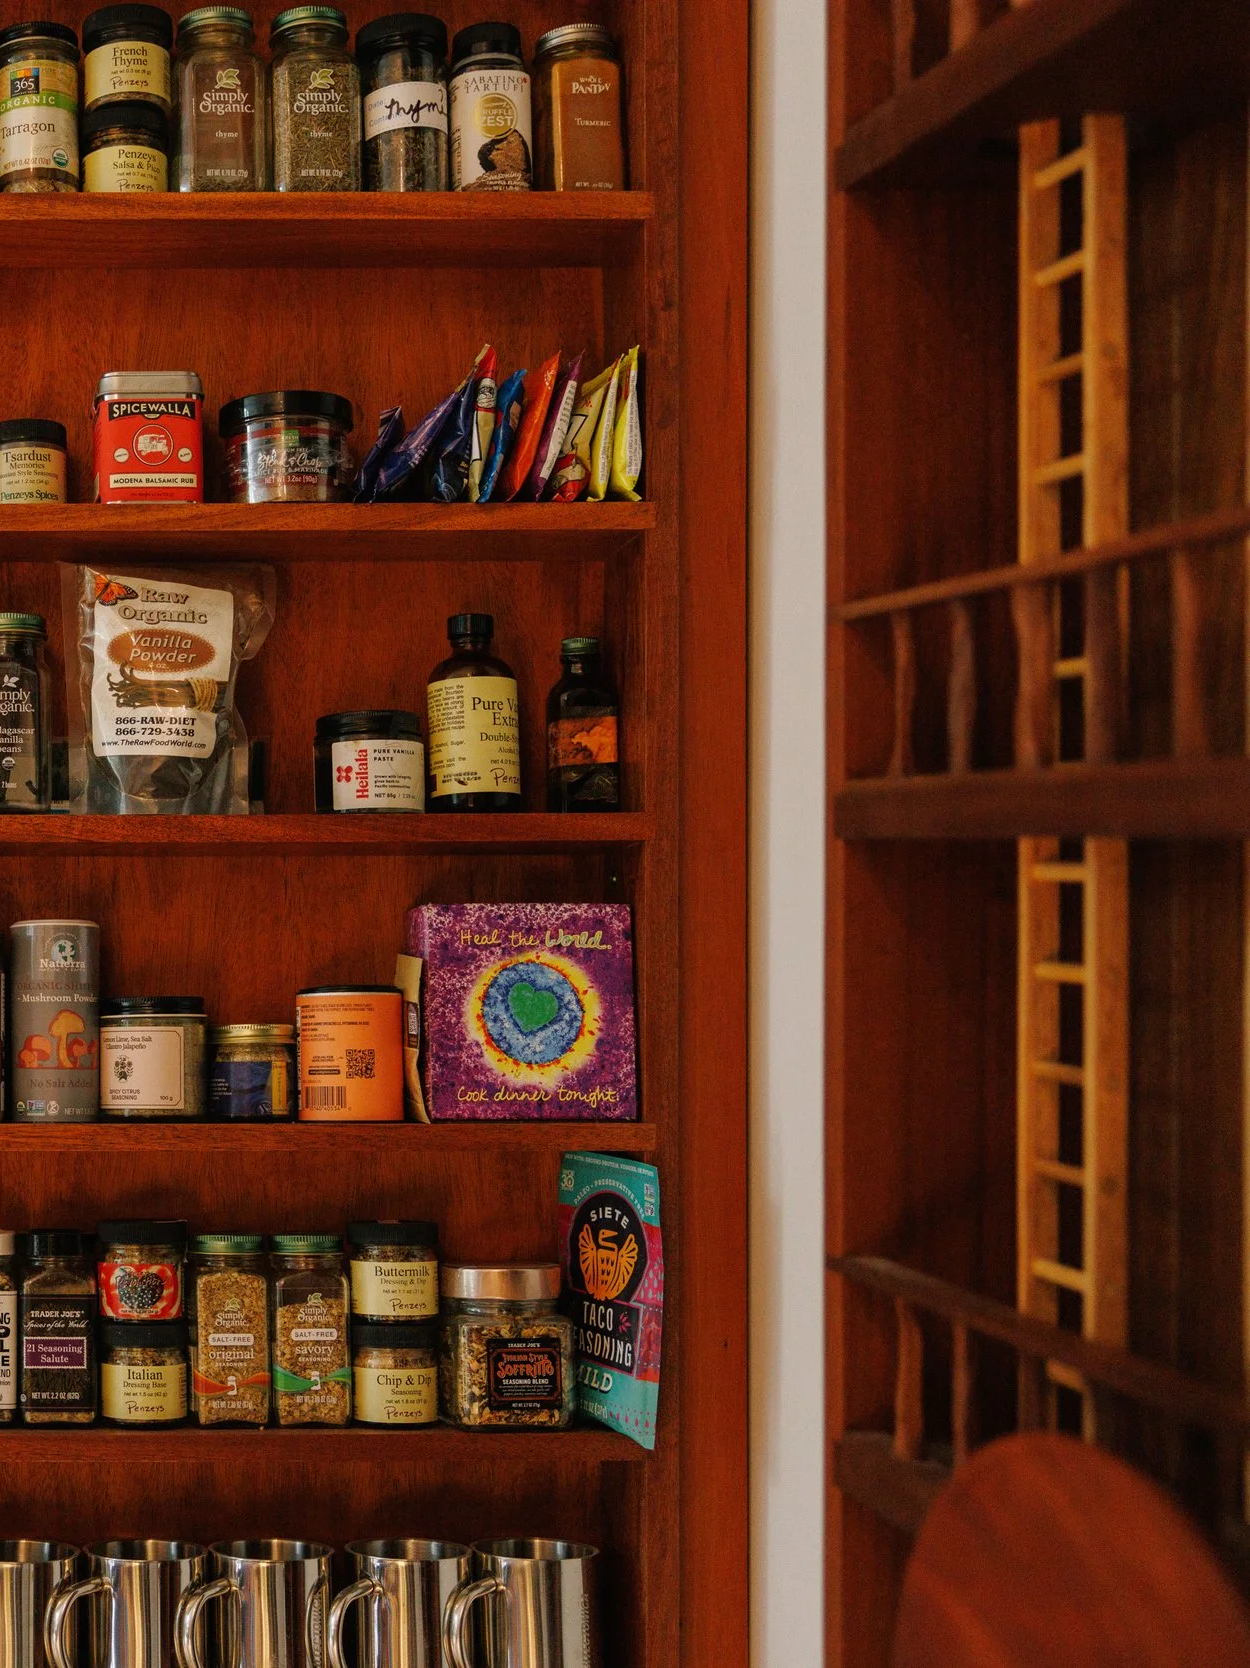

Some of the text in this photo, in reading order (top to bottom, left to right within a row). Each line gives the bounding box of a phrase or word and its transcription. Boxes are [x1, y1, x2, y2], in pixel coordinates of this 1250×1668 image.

[113, 47, 148, 56] French
[112, 56, 148, 67] Thyme
[14, 78, 34, 93] 365
[110, 76, 149, 89] Penzeys
[465, 76, 523, 85] SABATINO
[466, 84, 524, 93] TARTUFI
[0, 96, 56, 111] ORGANIC
[203, 90, 248, 106] Simply
[297, 90, 342, 106] Simply
[480, 116, 513, 126] ZEST
[1, 121, 55, 140] Tarragon
[118, 149, 157, 162] Penzeys
[116, 178, 153, 192] Penzeys
[113, 403, 191, 417] SPICEWALLA
[3, 451, 51, 463] Tsardust
[139, 587, 189, 604] Raw
[118, 605, 208, 624] Organic
[131, 633, 193, 649] Vanilla
[129, 649, 197, 663] Powder
[472, 697, 503, 710] Pure
[115, 716, 197, 726] 866-RAW-DIET
[493, 712, 519, 727] Extra
[115, 727, 195, 737] 866-729-3438
[102, 738, 206, 749] www.TheRawFoodWorld.com
[355, 749, 369, 799] Heilala
[460, 930, 612, 950] Heal the World.
[40, 959, 86, 968] Natierra
[458, 1086, 620, 1109] Cook dinner tonight.
[574, 1185, 590, 1204] PALEO
[595, 1179, 634, 1200] PRESERVATIVE
[591, 1207, 629, 1229] SIETE
[374, 1265, 430, 1277] Buttermilk
[389, 1298, 427, 1311] Penzeys
[217, 1311, 244, 1322] Simply
[300, 1306, 327, 1318] Simply
[584, 1301, 614, 1331] TACO
[38, 1344, 83, 1354] Seasoning
[295, 1345, 334, 1356] savory
[574, 1327, 632, 1367] EASONING
[40, 1354, 69, 1363] Salute
[209, 1349, 254, 1361] original
[127, 1369, 163, 1380] Italian
[497, 1359, 555, 1378] SOFFRITTO
[376, 1374, 431, 1388] Chip & Dip
[391, 1388, 422, 1396] Seasoning
[125, 1401, 164, 1414] Penzeys
[384, 1406, 423, 1419] Penzeys
